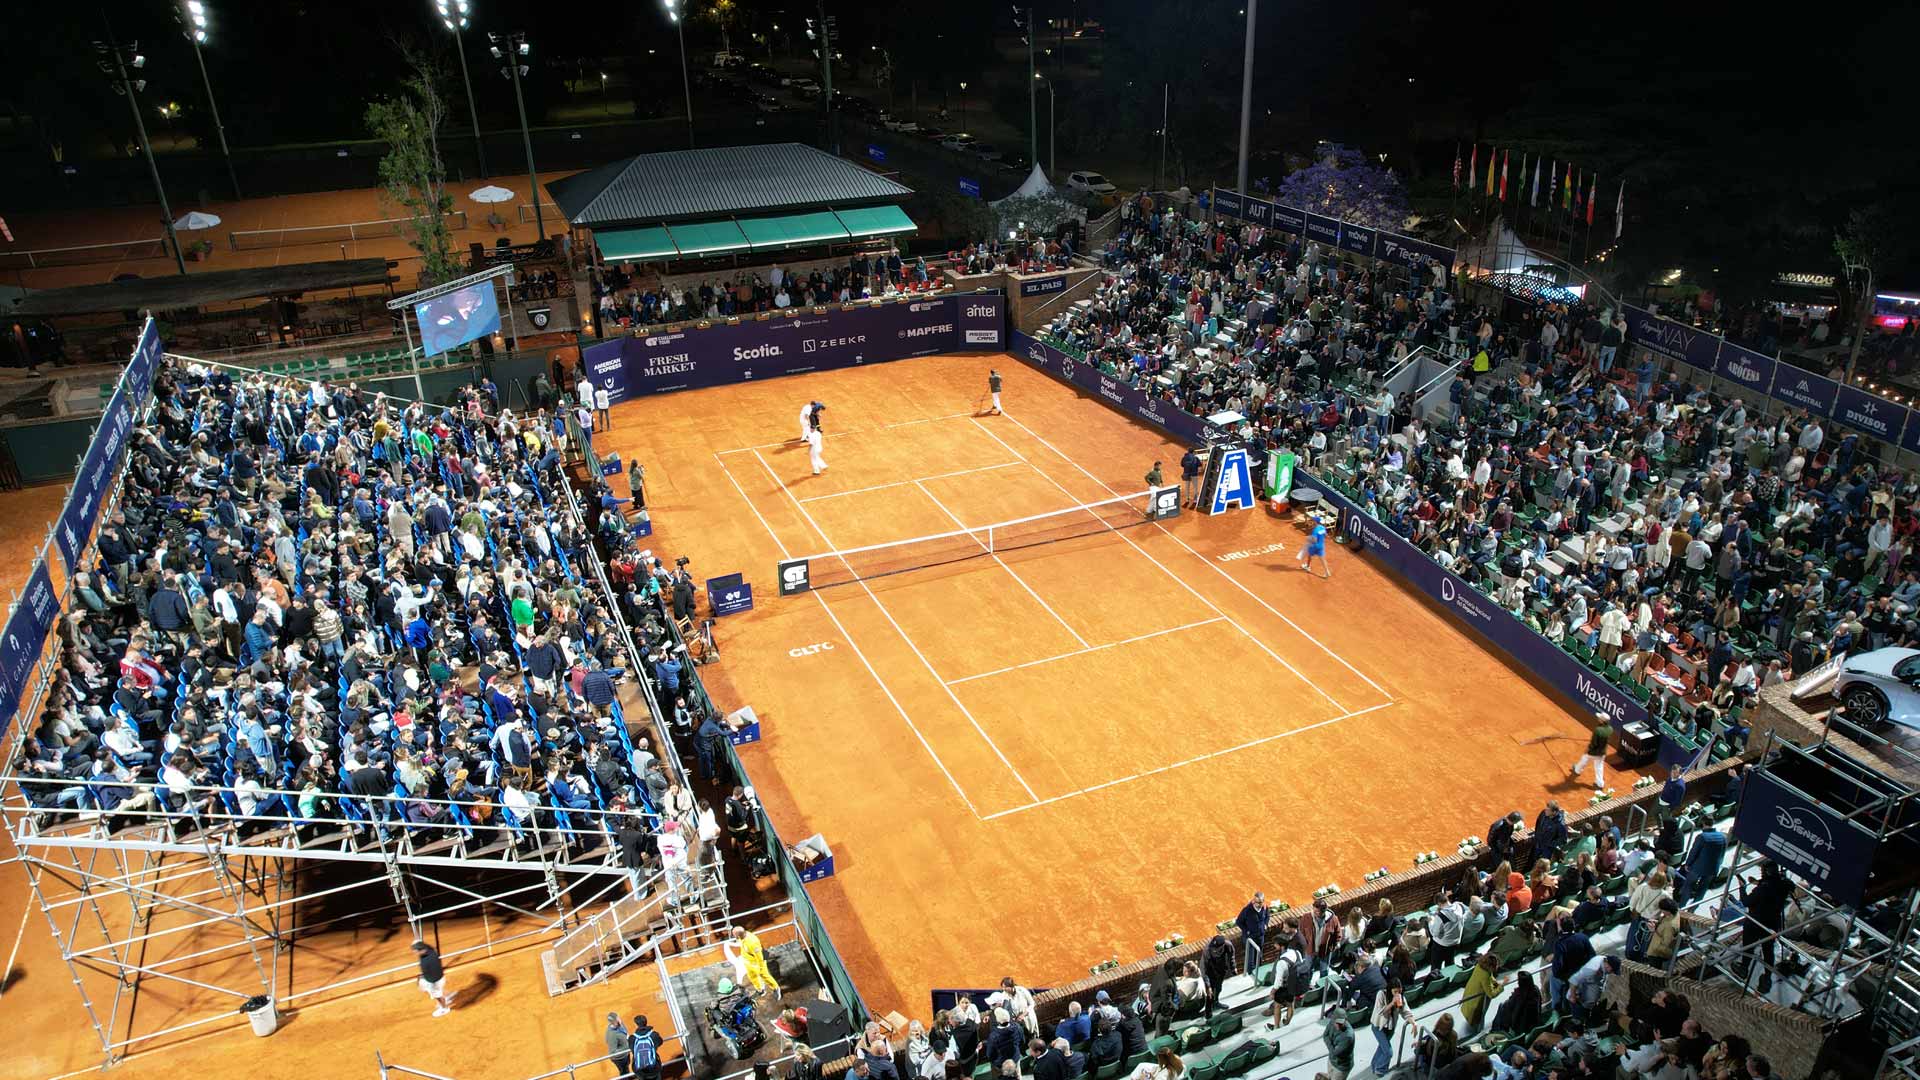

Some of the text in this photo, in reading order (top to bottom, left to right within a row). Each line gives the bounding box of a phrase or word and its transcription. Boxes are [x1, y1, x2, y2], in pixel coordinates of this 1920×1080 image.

[966, 304, 996, 318] antel
[907, 323, 953, 337] MAPFRE
[820, 335, 866, 348] ZEEKR
[594, 357, 621, 371] AMERICAN
[598, 362, 622, 375] EXPRESS
[648, 353, 689, 367] FRESH
[644, 361, 697, 377] MARKET
[1780, 387, 1823, 409] MAR AUSTRAL
[1139, 406, 1165, 424] PROSEGUR
[1846, 409, 1888, 432] DIVISOL
[1363, 525, 1391, 550] Montevideo
[788, 641, 834, 658] CLTC
[1576, 673, 1625, 721] Maxine
[1776, 805, 1836, 851] Disney+
[1765, 832, 1832, 880] ESPN
